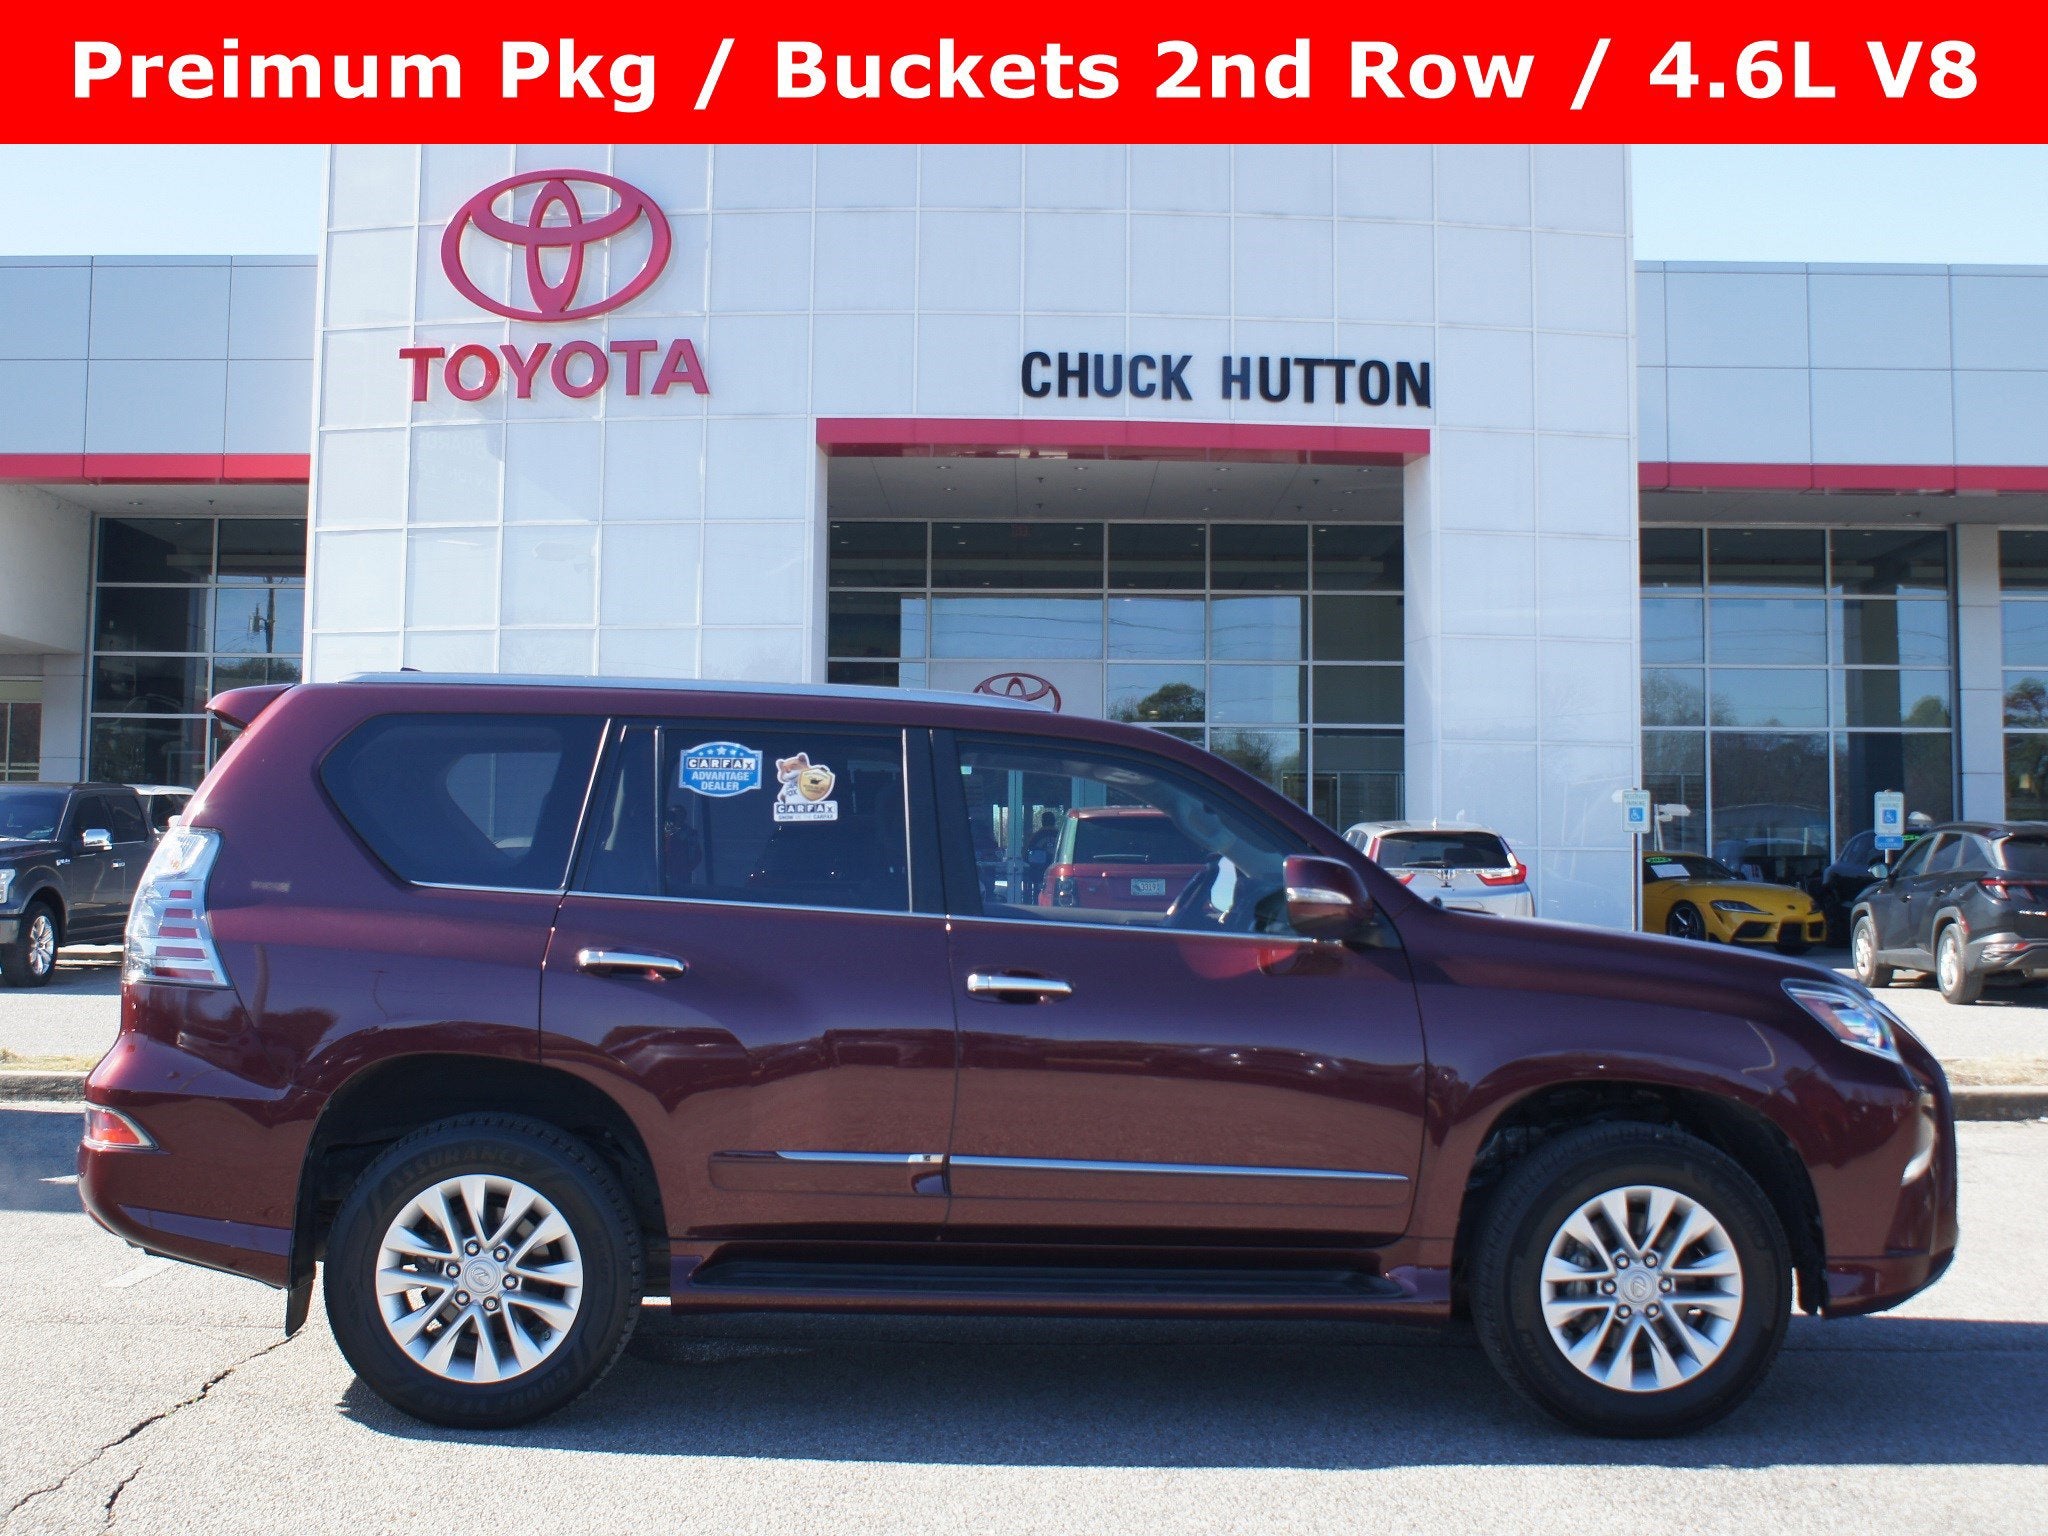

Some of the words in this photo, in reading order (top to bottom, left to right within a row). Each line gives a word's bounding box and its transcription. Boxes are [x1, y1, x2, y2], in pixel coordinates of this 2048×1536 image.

[400, 339, 709, 403] TOYOTA
[1021, 350, 1193, 401] CHUCK
[1221, 355, 1432, 409] HUTTON
[688, 758, 756, 771] CARFAX
[691, 770, 750, 781] ADVANTAGE
[700, 781, 740, 791] DEALER
[776, 803, 834, 815] CARFAX
[391, 1147, 530, 1192] ASSURANCE
